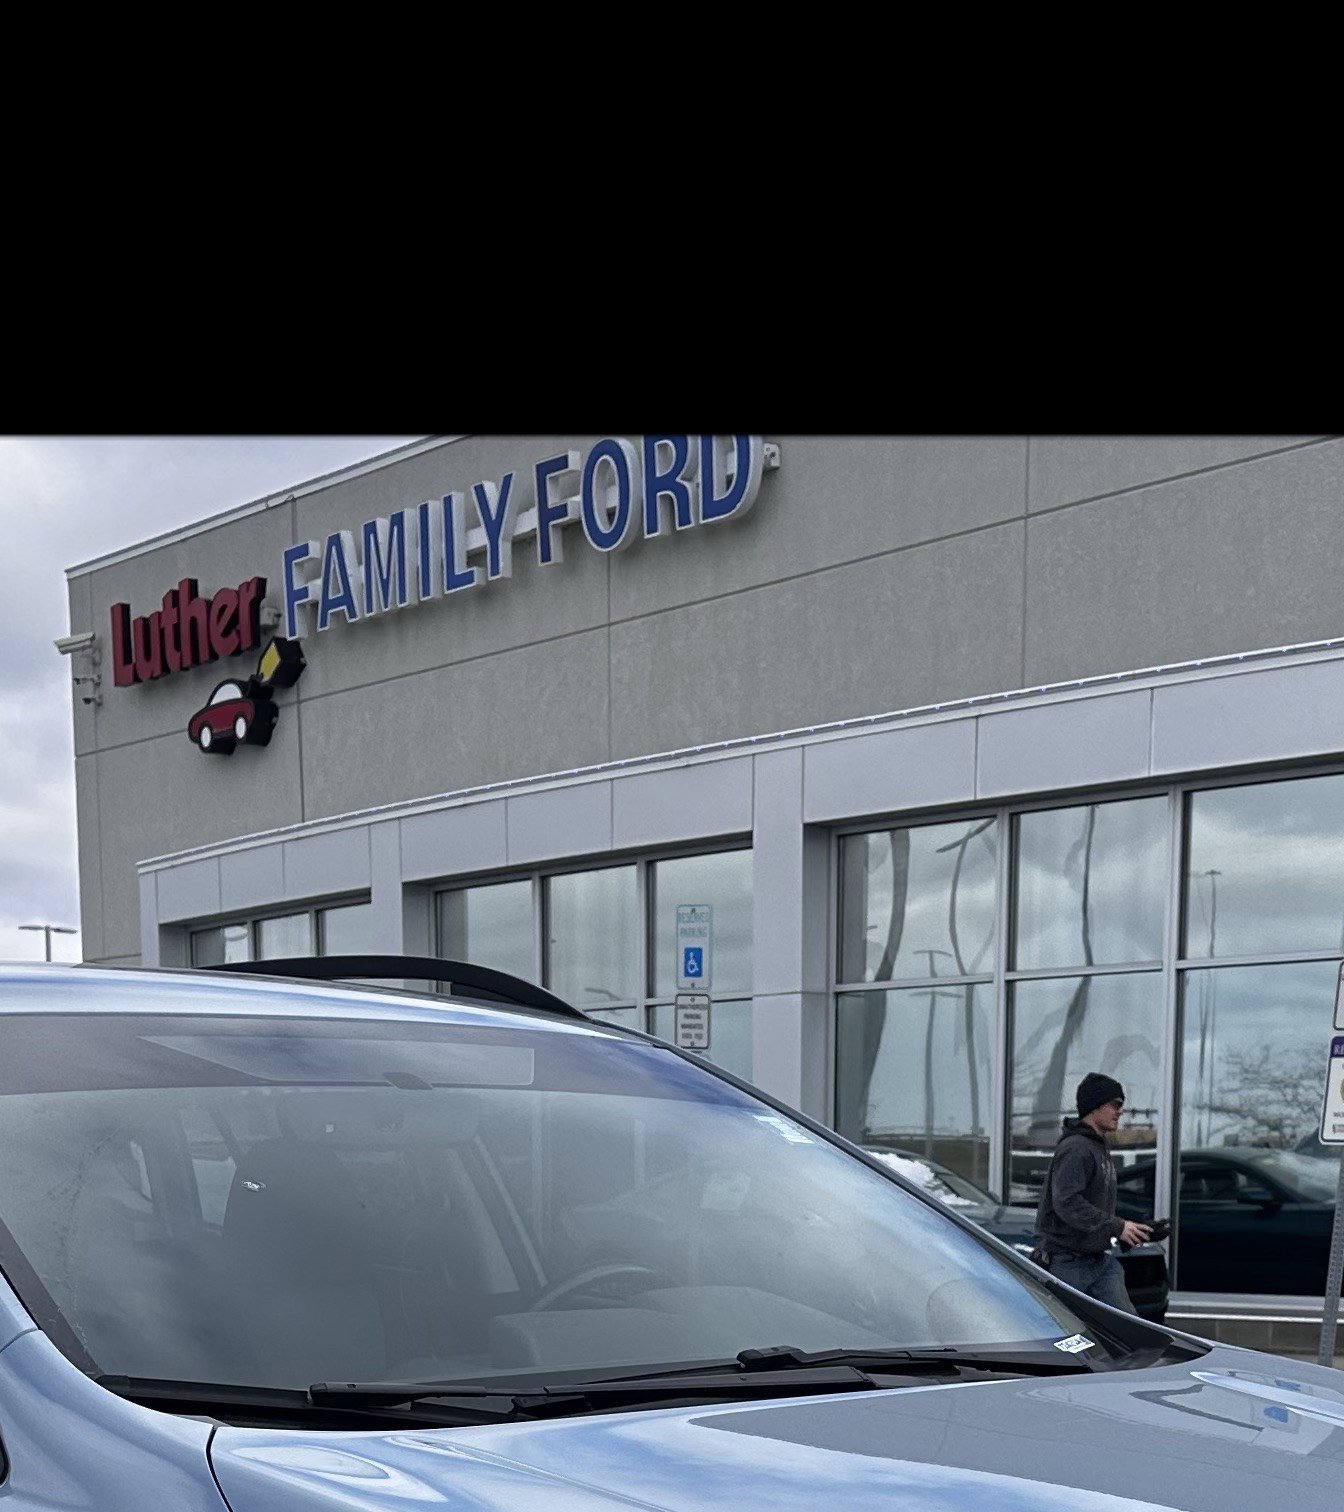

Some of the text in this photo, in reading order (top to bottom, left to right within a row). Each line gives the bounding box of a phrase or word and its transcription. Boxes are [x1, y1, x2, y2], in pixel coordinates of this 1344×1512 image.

[282, 434, 763, 641] FAMILY FORD
[110, 576, 267, 688] Luther
